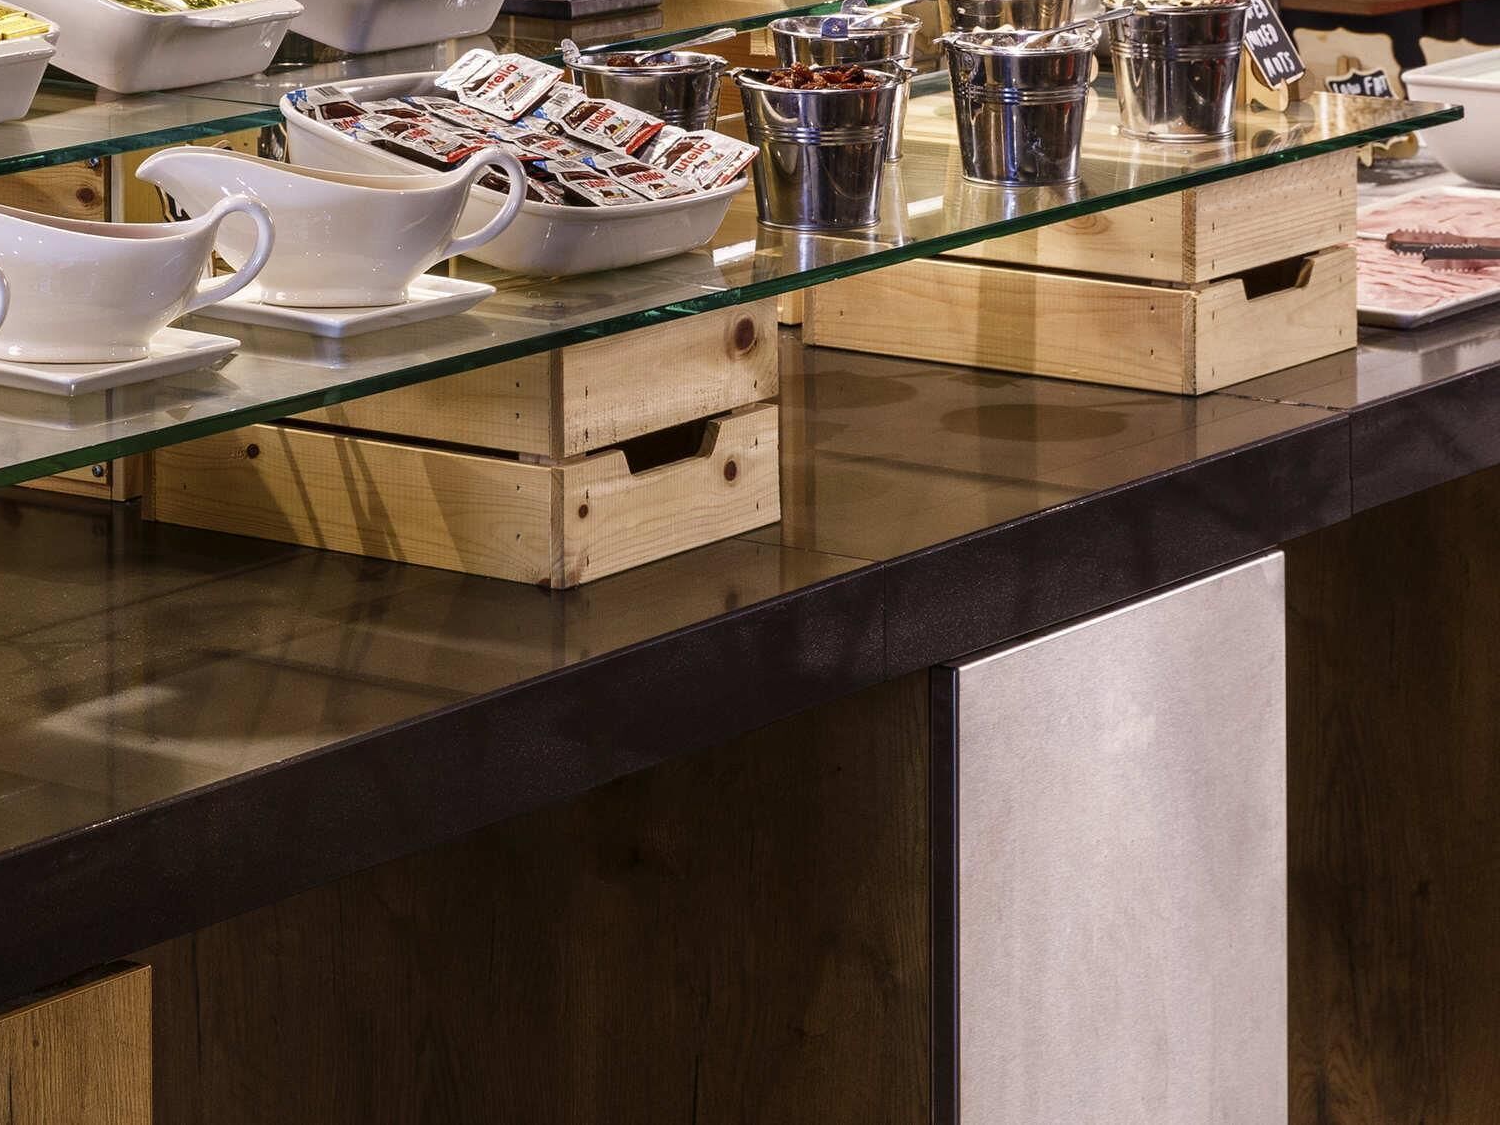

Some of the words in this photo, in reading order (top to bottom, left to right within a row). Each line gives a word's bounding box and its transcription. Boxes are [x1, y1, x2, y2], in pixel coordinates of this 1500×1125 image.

[476, 62, 519, 98] nutella
[582, 106, 618, 134] nutella
[670, 141, 713, 176] nutella
